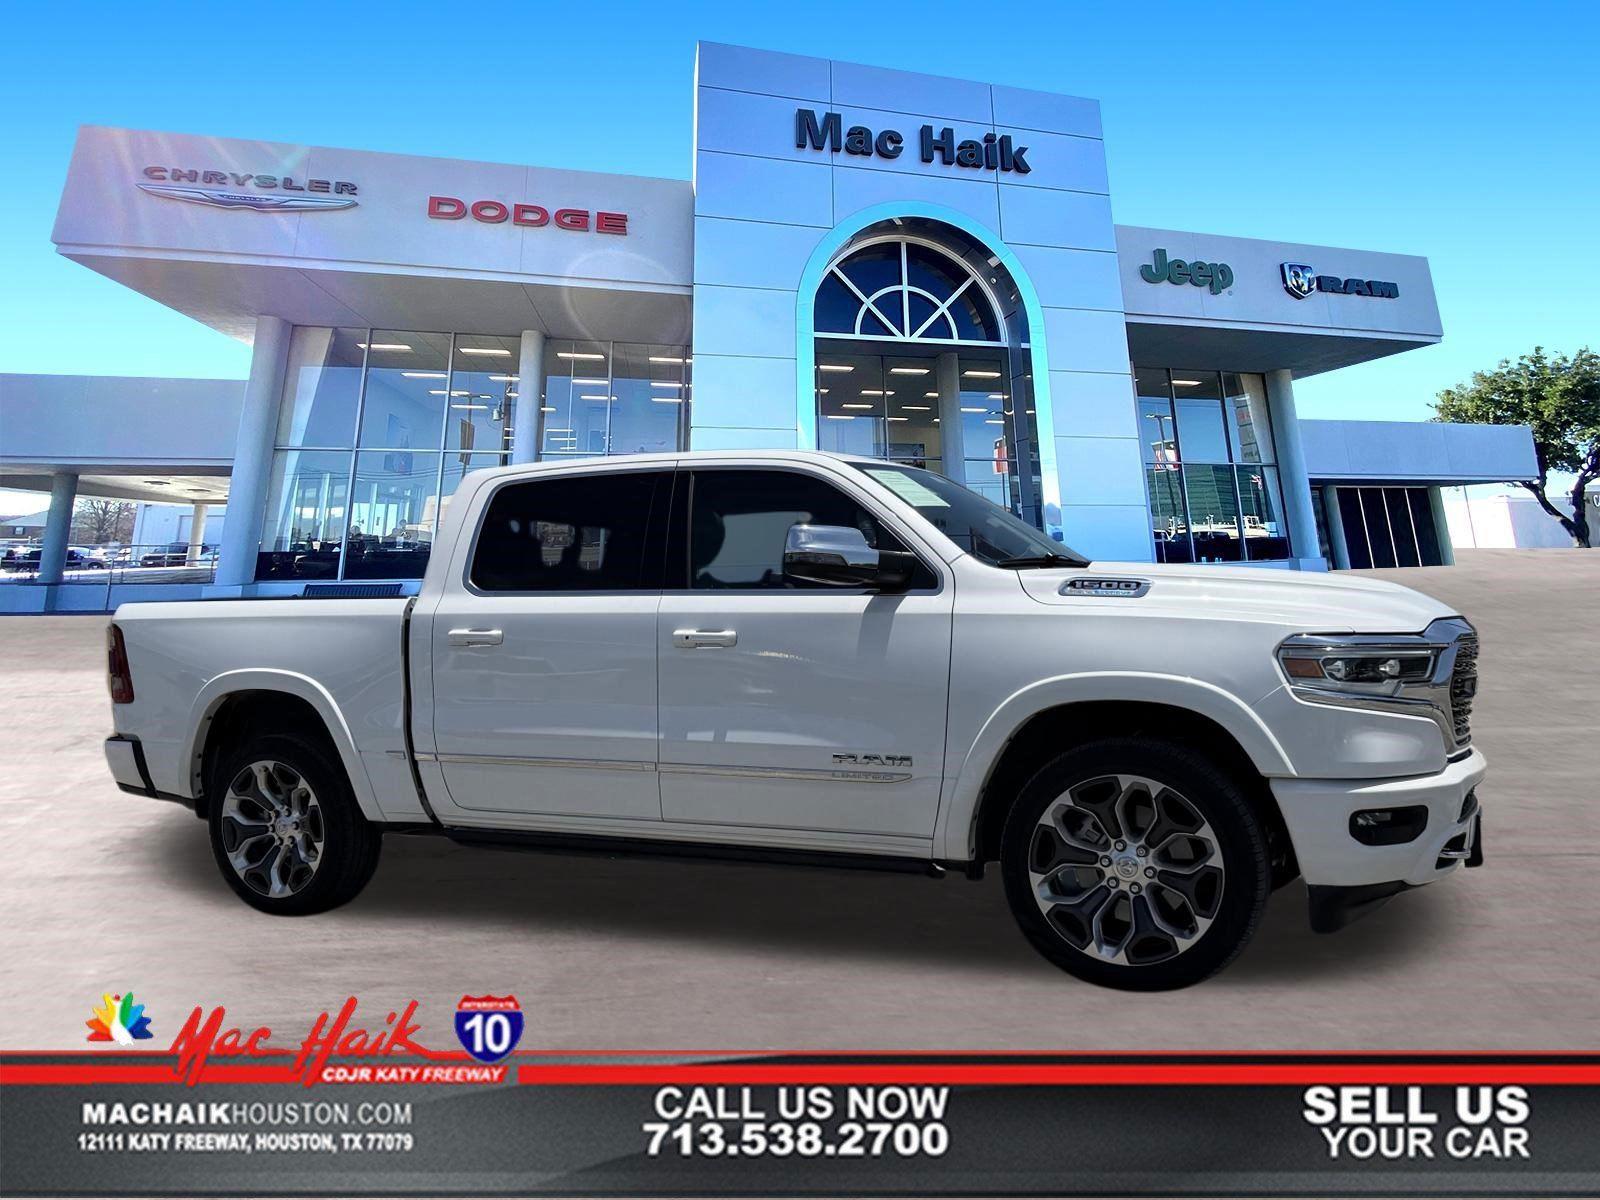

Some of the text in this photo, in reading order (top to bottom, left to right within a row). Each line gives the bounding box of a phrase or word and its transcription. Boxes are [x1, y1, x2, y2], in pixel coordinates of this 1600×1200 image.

[795, 108, 1032, 174] Mac Haik
[143, 166, 358, 196] CHRYSLER
[428, 196, 628, 235] DODGE
[1140, 248, 1234, 295] Jeep
[1316, 275, 1399, 298] RAM
[1072, 580, 1138, 591] 1500
[832, 752, 913, 768] RAM
